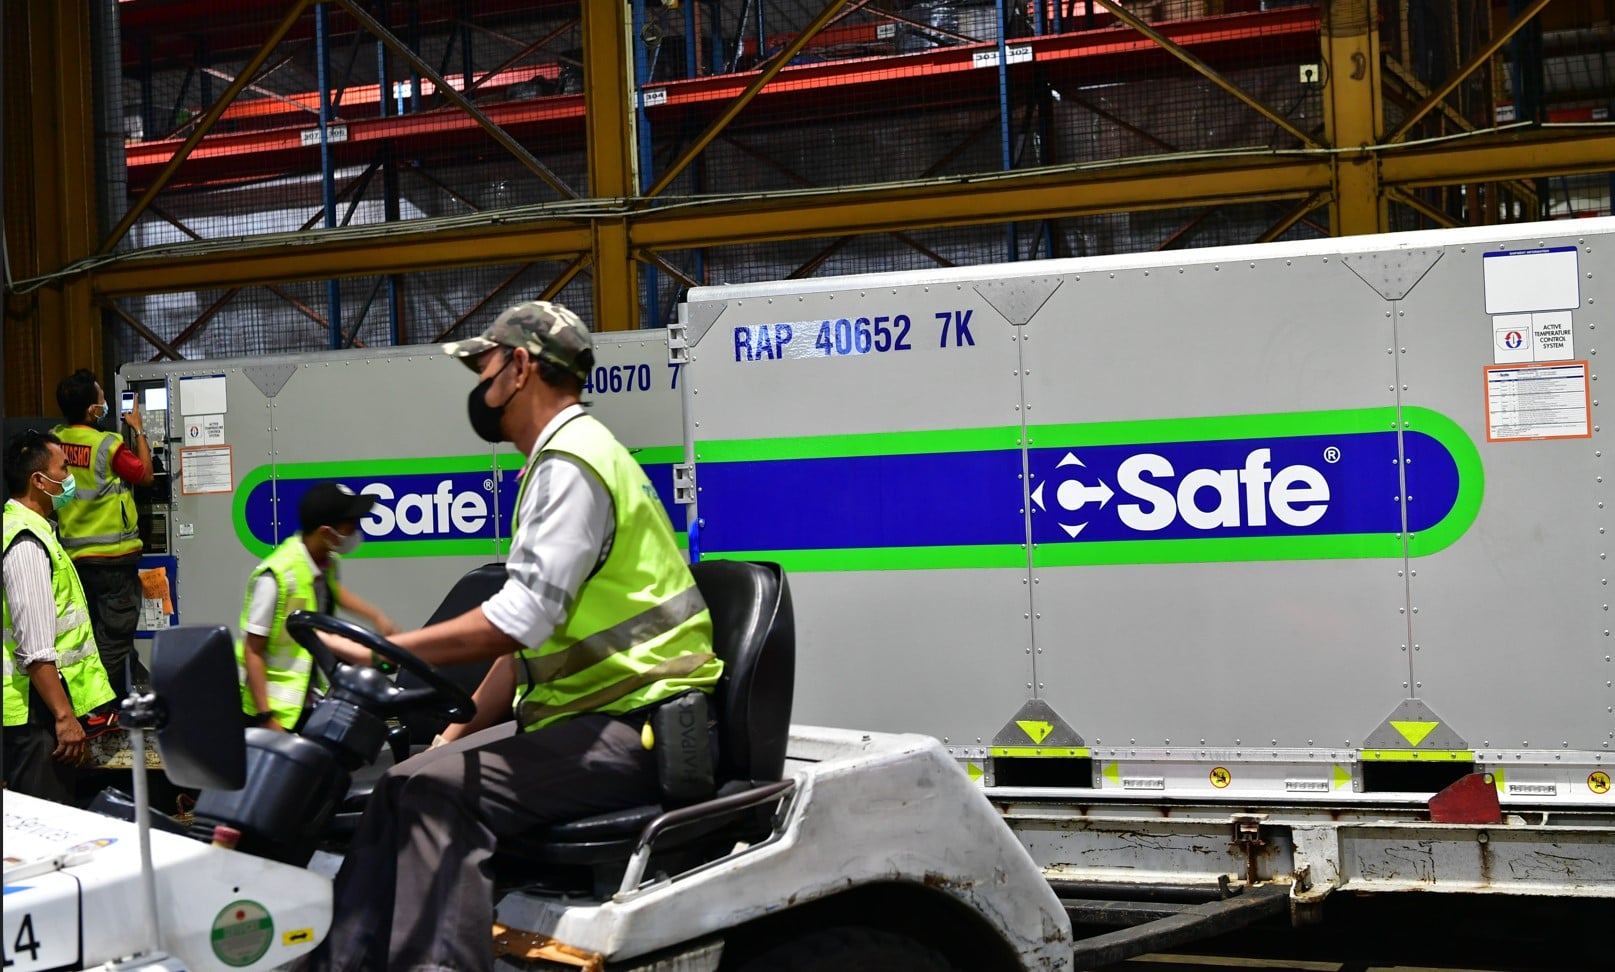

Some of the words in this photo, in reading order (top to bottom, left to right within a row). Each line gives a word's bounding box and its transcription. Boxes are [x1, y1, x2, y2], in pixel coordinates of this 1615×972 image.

[734, 325, 793, 362] RAP
[815, 314, 912, 356] 40652
[935, 310, 975, 348] 7K
